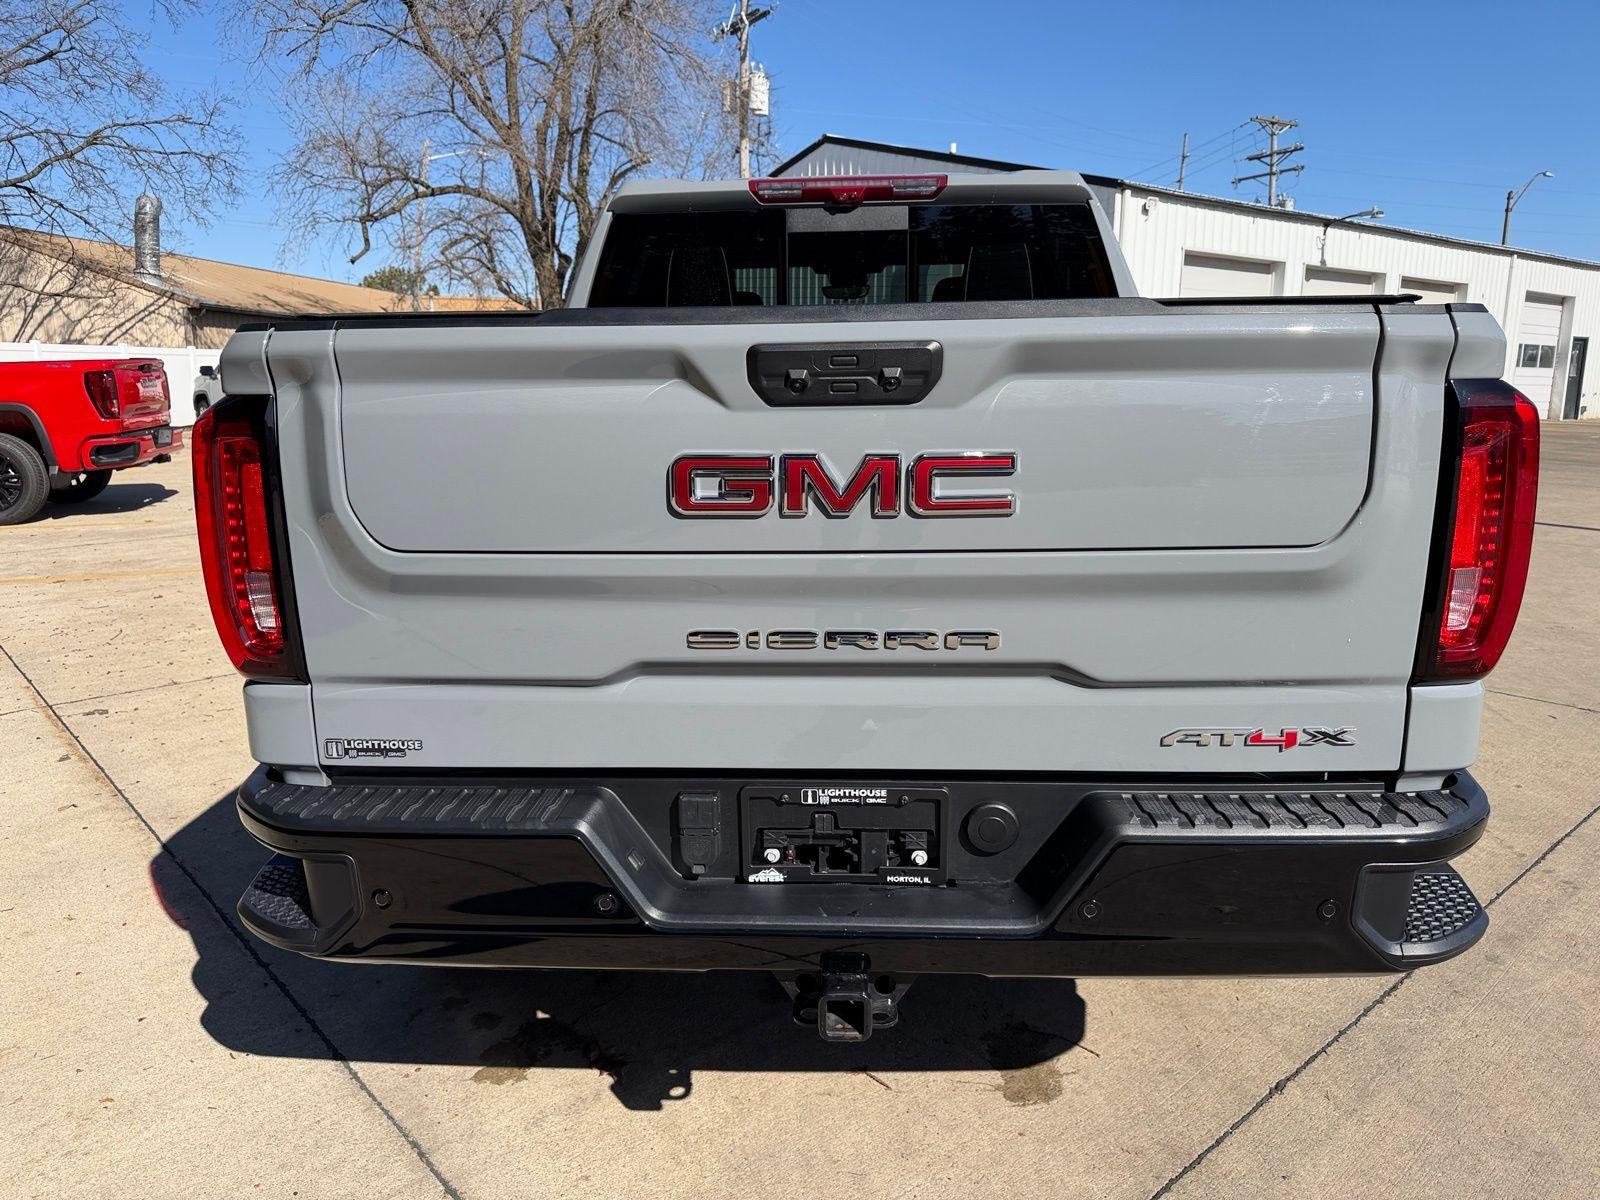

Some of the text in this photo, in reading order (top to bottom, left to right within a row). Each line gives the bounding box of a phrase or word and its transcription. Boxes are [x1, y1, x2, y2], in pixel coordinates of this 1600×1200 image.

[667, 450, 1017, 518] GMC
[686, 630, 1000, 650] SIERRA
[344, 740, 422, 750] LIGHTHOUSE
[1160, 727, 1357, 752] AT4X
[818, 788, 887, 797] LIGHTHOUSE
[886, 875, 931, 884] MORTON, IL
